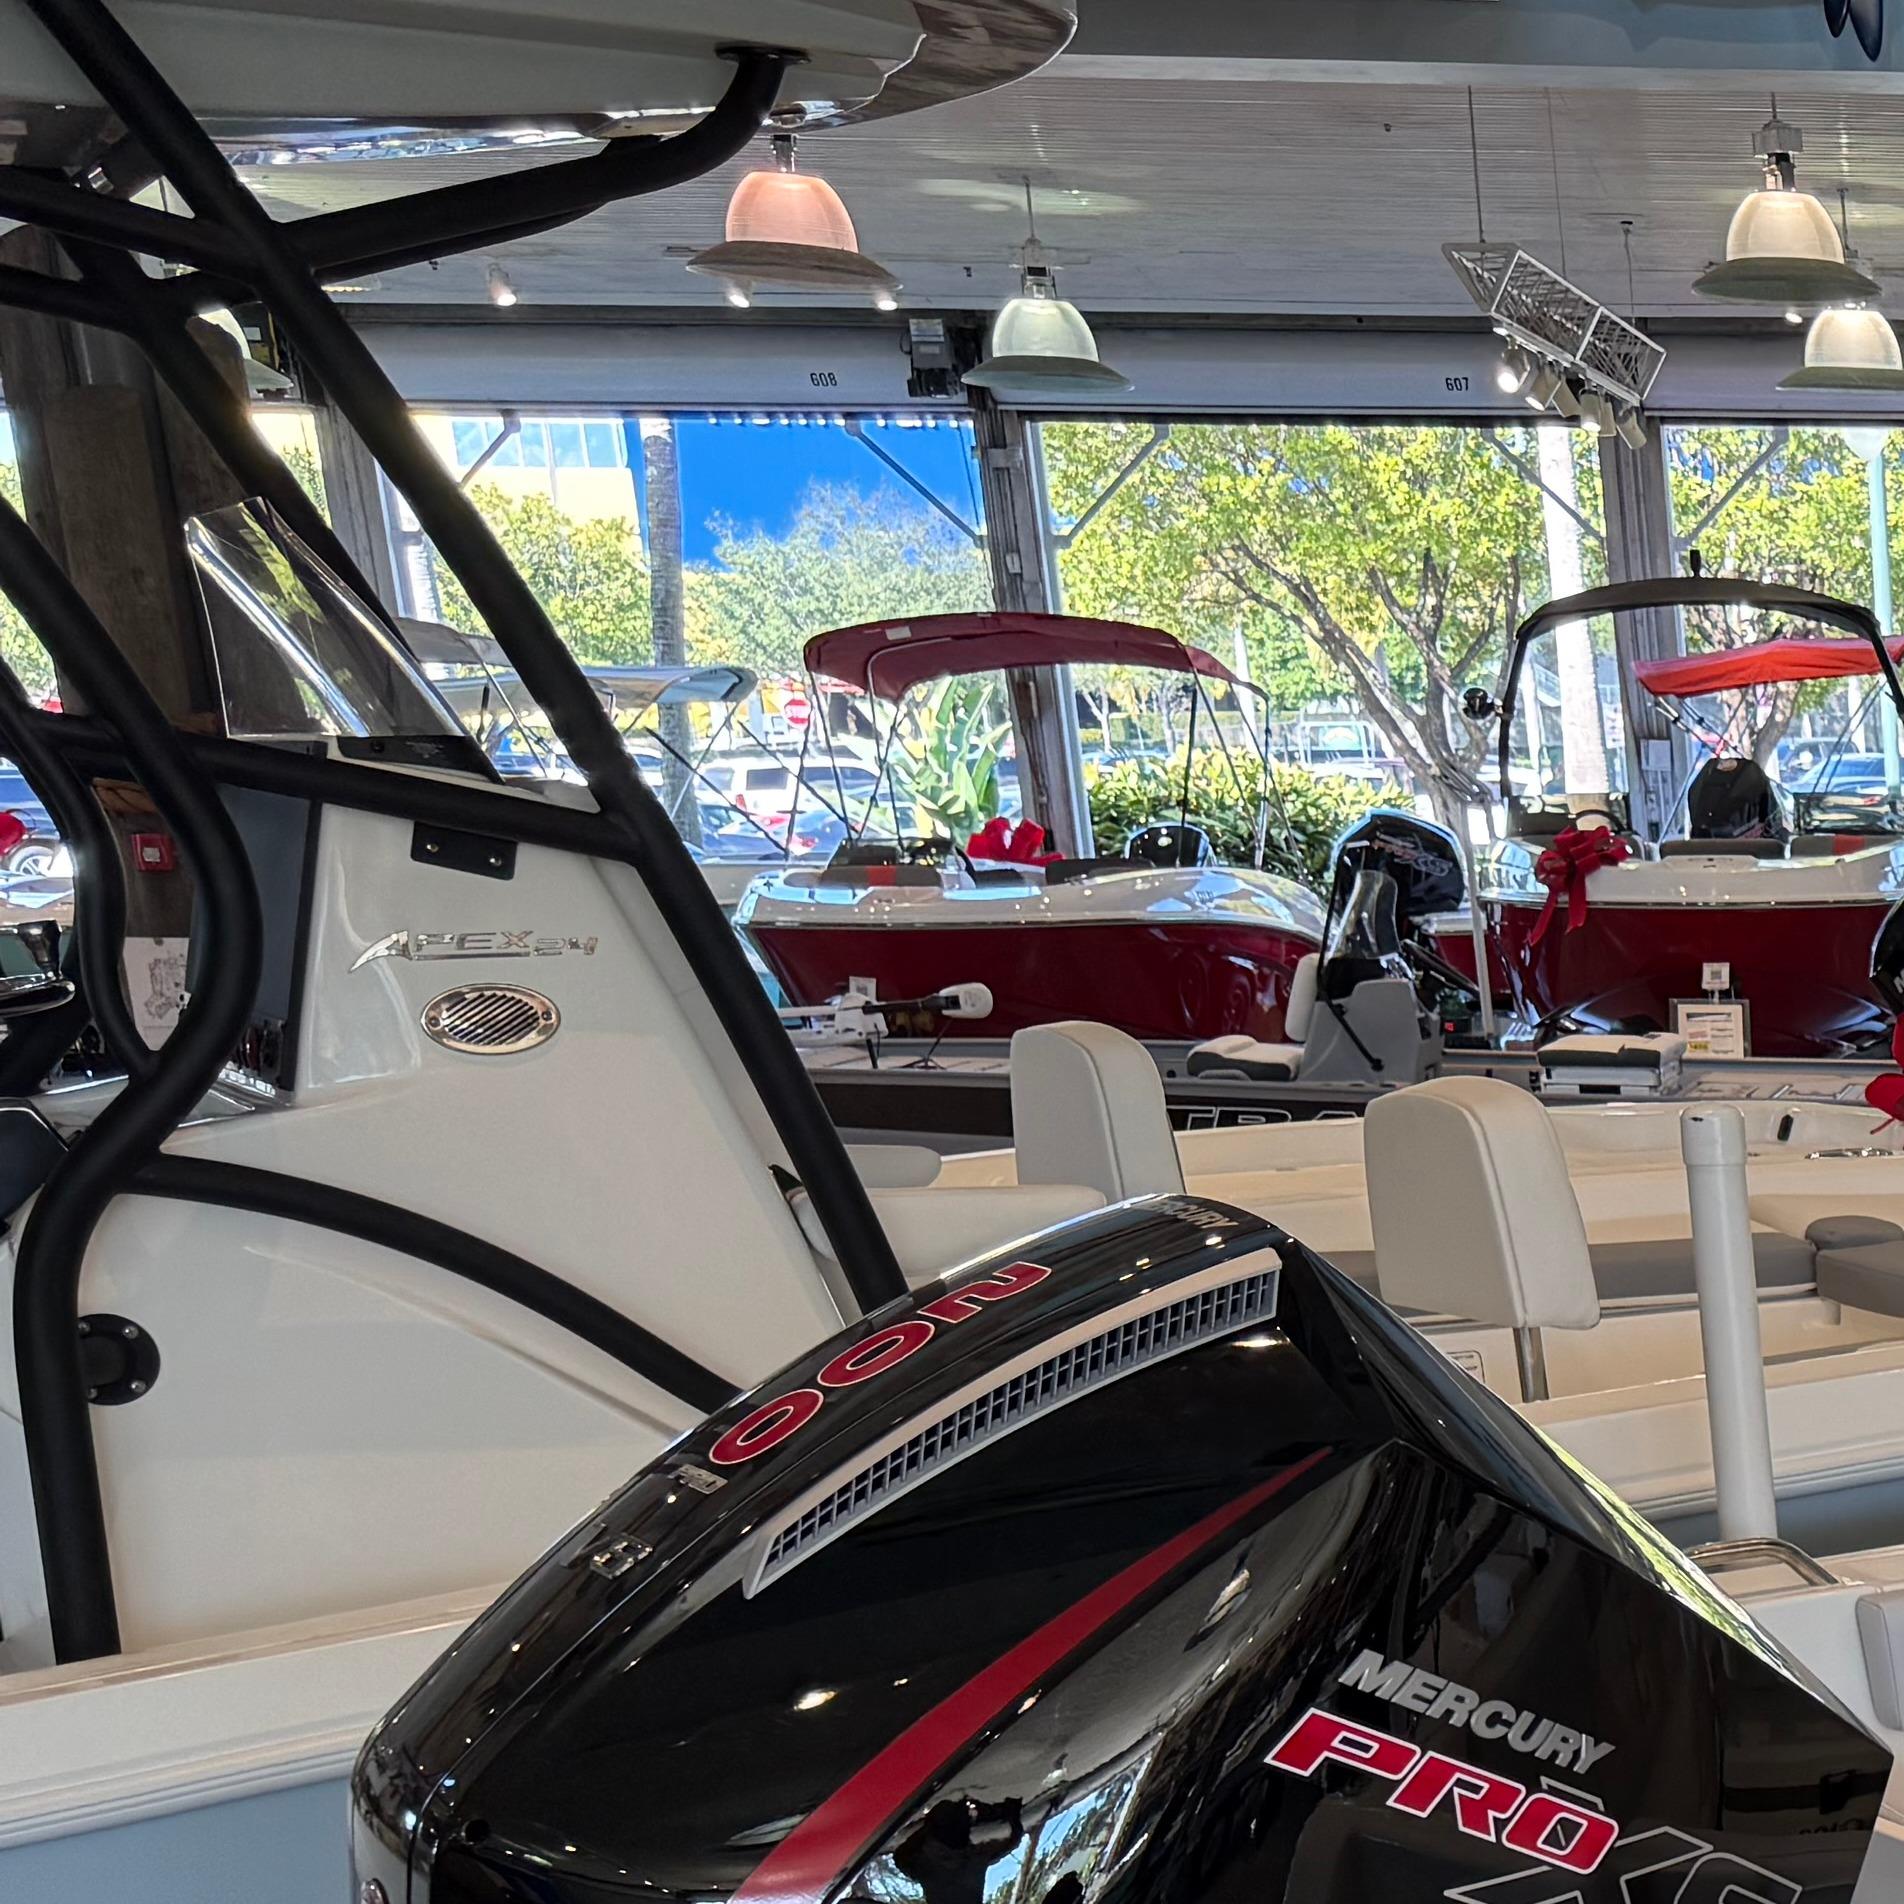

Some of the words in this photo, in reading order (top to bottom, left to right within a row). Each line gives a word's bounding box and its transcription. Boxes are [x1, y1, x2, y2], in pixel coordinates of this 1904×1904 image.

[810, 372, 837, 387] 608
[1445, 377, 1469, 391] 607
[1338, 1648, 1616, 1775] MERCURY
[1264, 1706, 1620, 1875] PRO
